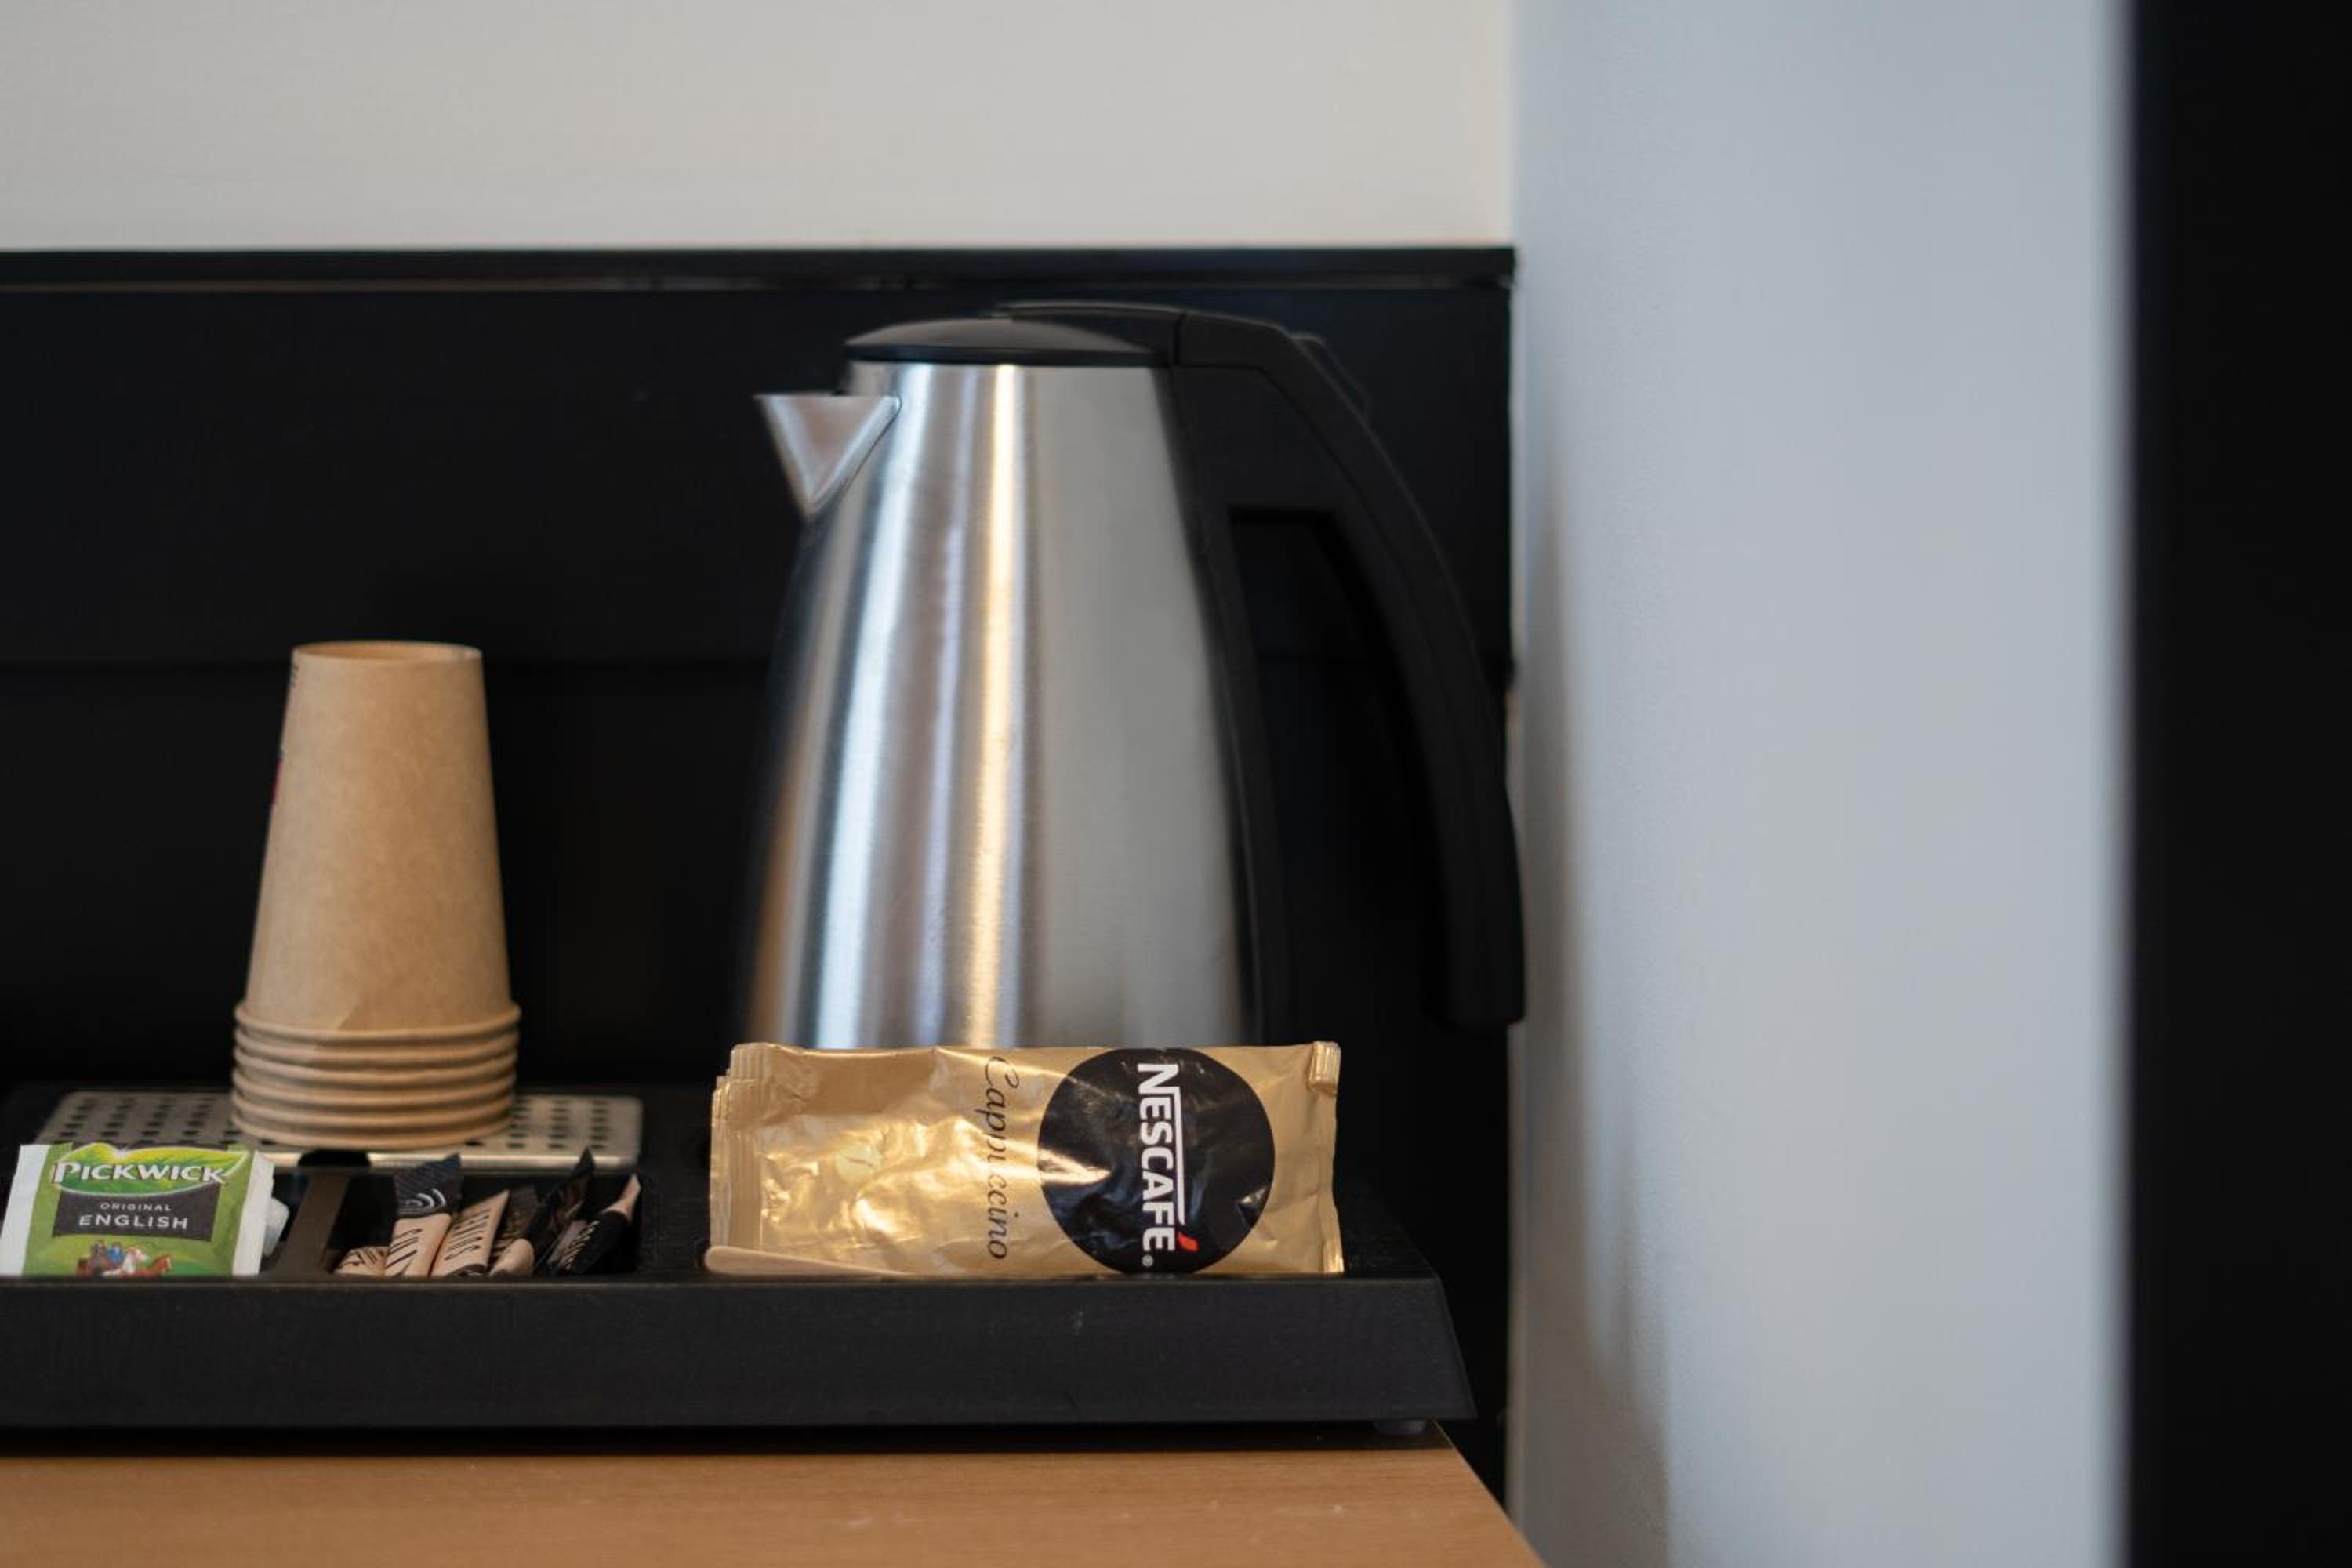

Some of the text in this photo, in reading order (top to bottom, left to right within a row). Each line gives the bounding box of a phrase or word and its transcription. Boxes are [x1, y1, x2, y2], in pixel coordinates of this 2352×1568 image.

[53, 1163, 225, 1183] PICKWICK
[100, 1203, 172, 1211] ORIGINAL
[79, 1215, 188, 1229] ENGLISH
